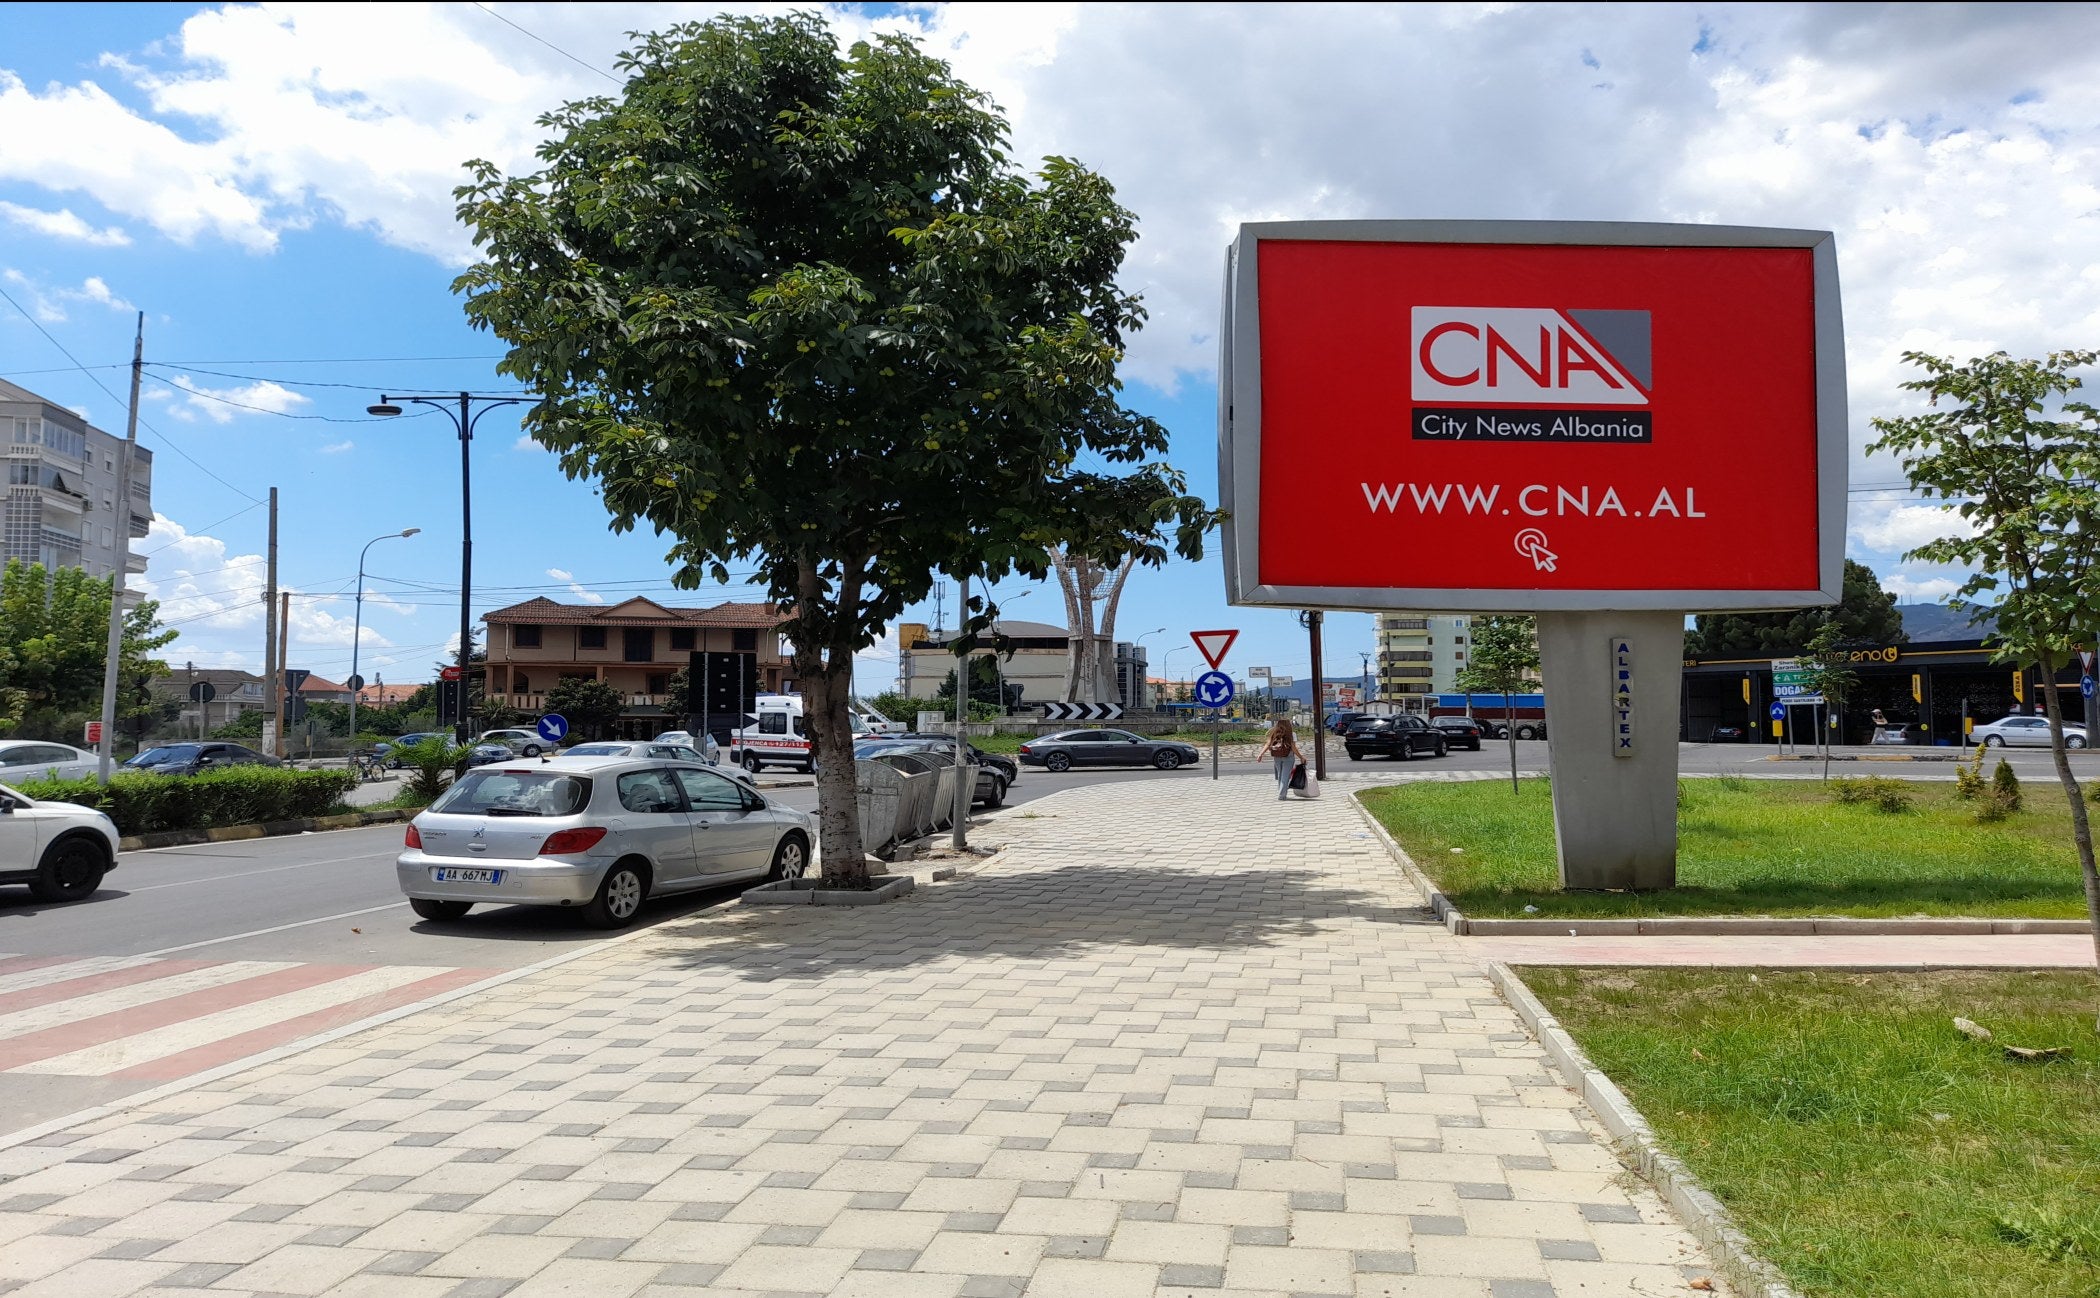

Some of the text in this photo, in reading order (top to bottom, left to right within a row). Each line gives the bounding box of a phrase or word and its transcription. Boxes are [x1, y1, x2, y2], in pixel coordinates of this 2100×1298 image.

[1419, 321, 1625, 389] CNA
[1421, 414, 1644, 440] City News Albania
[1361, 482, 1706, 518] WWW.CNA.AL
[1617, 643, 1632, 748] ALBARTEX
[1775, 685, 1807, 696] DOGA
[446, 869, 457, 880] AA
[462, 870, 480, 881] 667
